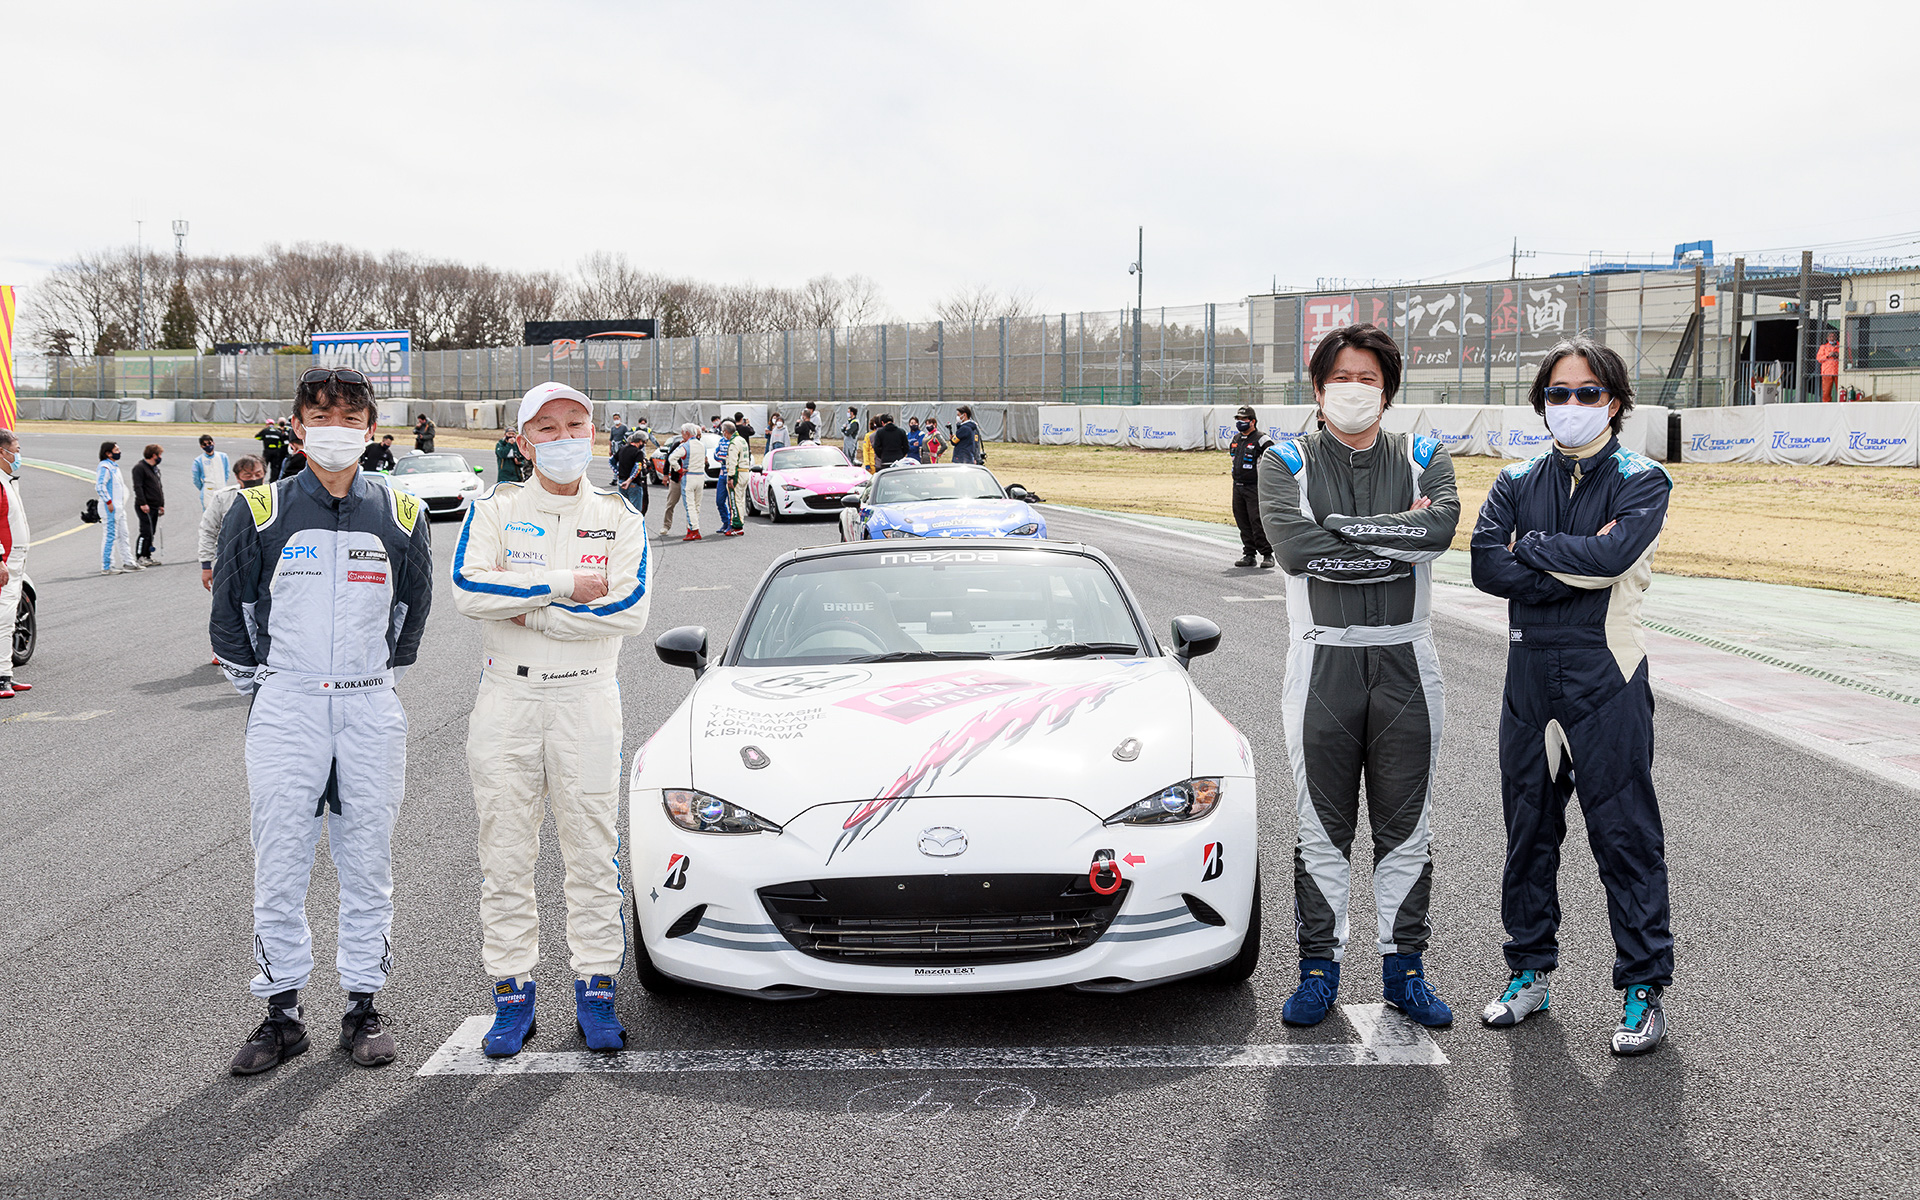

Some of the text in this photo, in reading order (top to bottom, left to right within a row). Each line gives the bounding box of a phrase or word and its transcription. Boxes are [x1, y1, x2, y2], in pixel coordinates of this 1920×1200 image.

[1889, 293, 1901, 309] 8
[318, 341, 402, 373] WAKO'S
[1412, 346, 1452, 365] Trust
[1710, 438, 1755, 446] TSUKUBA
[1340, 523, 1428, 538] alpinestars
[282, 545, 318, 560] SPK
[1307, 557, 1392, 571] alpinestars
[822, 601, 875, 612] BRIDE
[334, 677, 384, 690] K.OKAMOTO
[754, 670, 859, 694] 64
[864, 674, 986, 707] Car
[709, 711, 828, 724] Y.KUSAKABE
[712, 704, 822, 718] T.KOBAYASHI
[706, 719, 808, 732] K.OKAMOTO
[704, 727, 804, 740] K.ISHIKAWA
